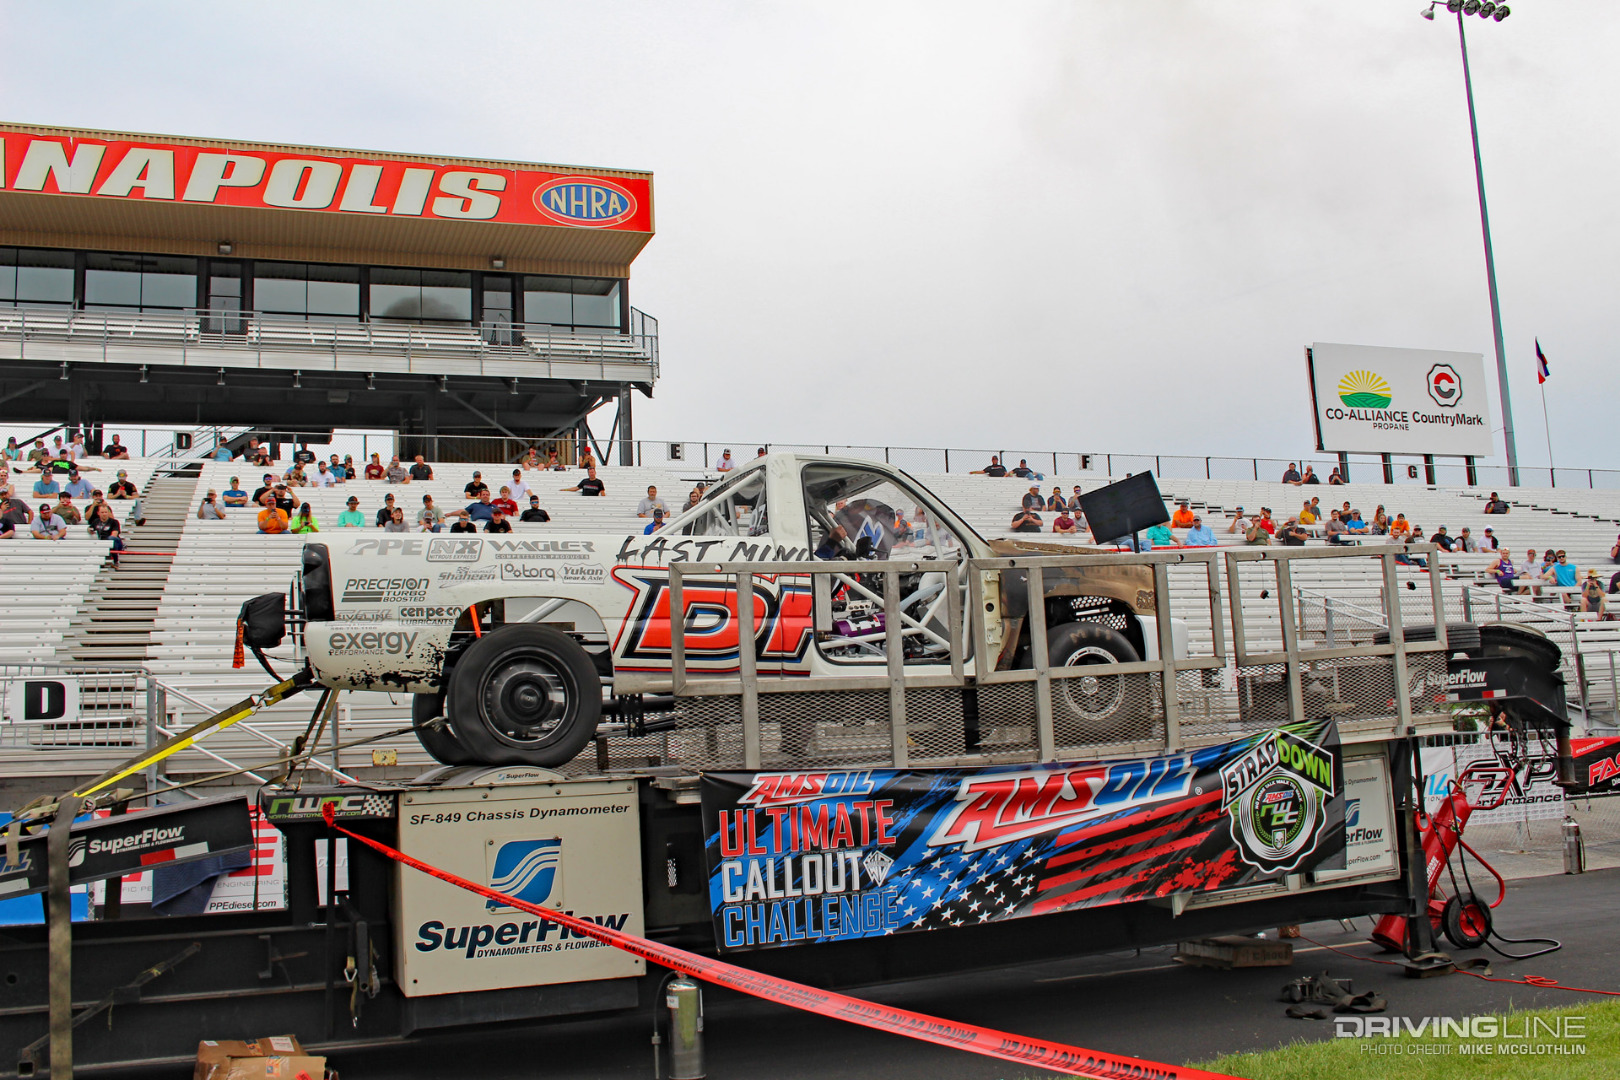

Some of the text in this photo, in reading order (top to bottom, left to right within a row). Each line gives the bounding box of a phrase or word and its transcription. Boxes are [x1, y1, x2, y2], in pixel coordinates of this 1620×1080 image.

[0, 137, 506, 220] NAPOLIS
[549, 184, 624, 220] NHRA
[1326, 408, 1409, 423] CO-ALLIANCE
[1412, 411, 1484, 426] CountryMark
[1373, 422, 1410, 431] PROPANE
[177, 433, 192, 449] D
[671, 445, 682, 459] E
[1081, 454, 1091, 470] F
[1407, 465, 1418, 479] G
[345, 538, 423, 556] PPE
[431, 540, 479, 555] NX
[487, 540, 596, 552] WAGLER
[616, 535, 725, 566] LAST
[438, 570, 497, 581] Shaheen
[563, 566, 604, 576] Yukon
[401, 618, 454, 626] LUBRICANTS
[329, 631, 419, 655] exergy
[329, 648, 385, 656] PERFORMANCE
[25, 681, 66, 720] D
[505, 772, 540, 780] SuperFlow
[1227, 738, 1331, 798] STRAP DOWN
[736, 770, 876, 808] AMSOIL
[927, 753, 1199, 853] AMSOIL
[409, 803, 631, 827] SF-849 Chassis Dynamometer
[718, 799, 897, 858] ULTIMATE
[1346, 827, 1383, 843] erFlow
[88, 826, 184, 855] SuperFlow
[721, 850, 863, 903] CALLOUT
[722, 890, 899, 948] CHALLENGE
[415, 910, 630, 959] SuperFlow
[477, 943, 553, 958] DYNAMOMETERS
[555, 942, 562, 951] &
